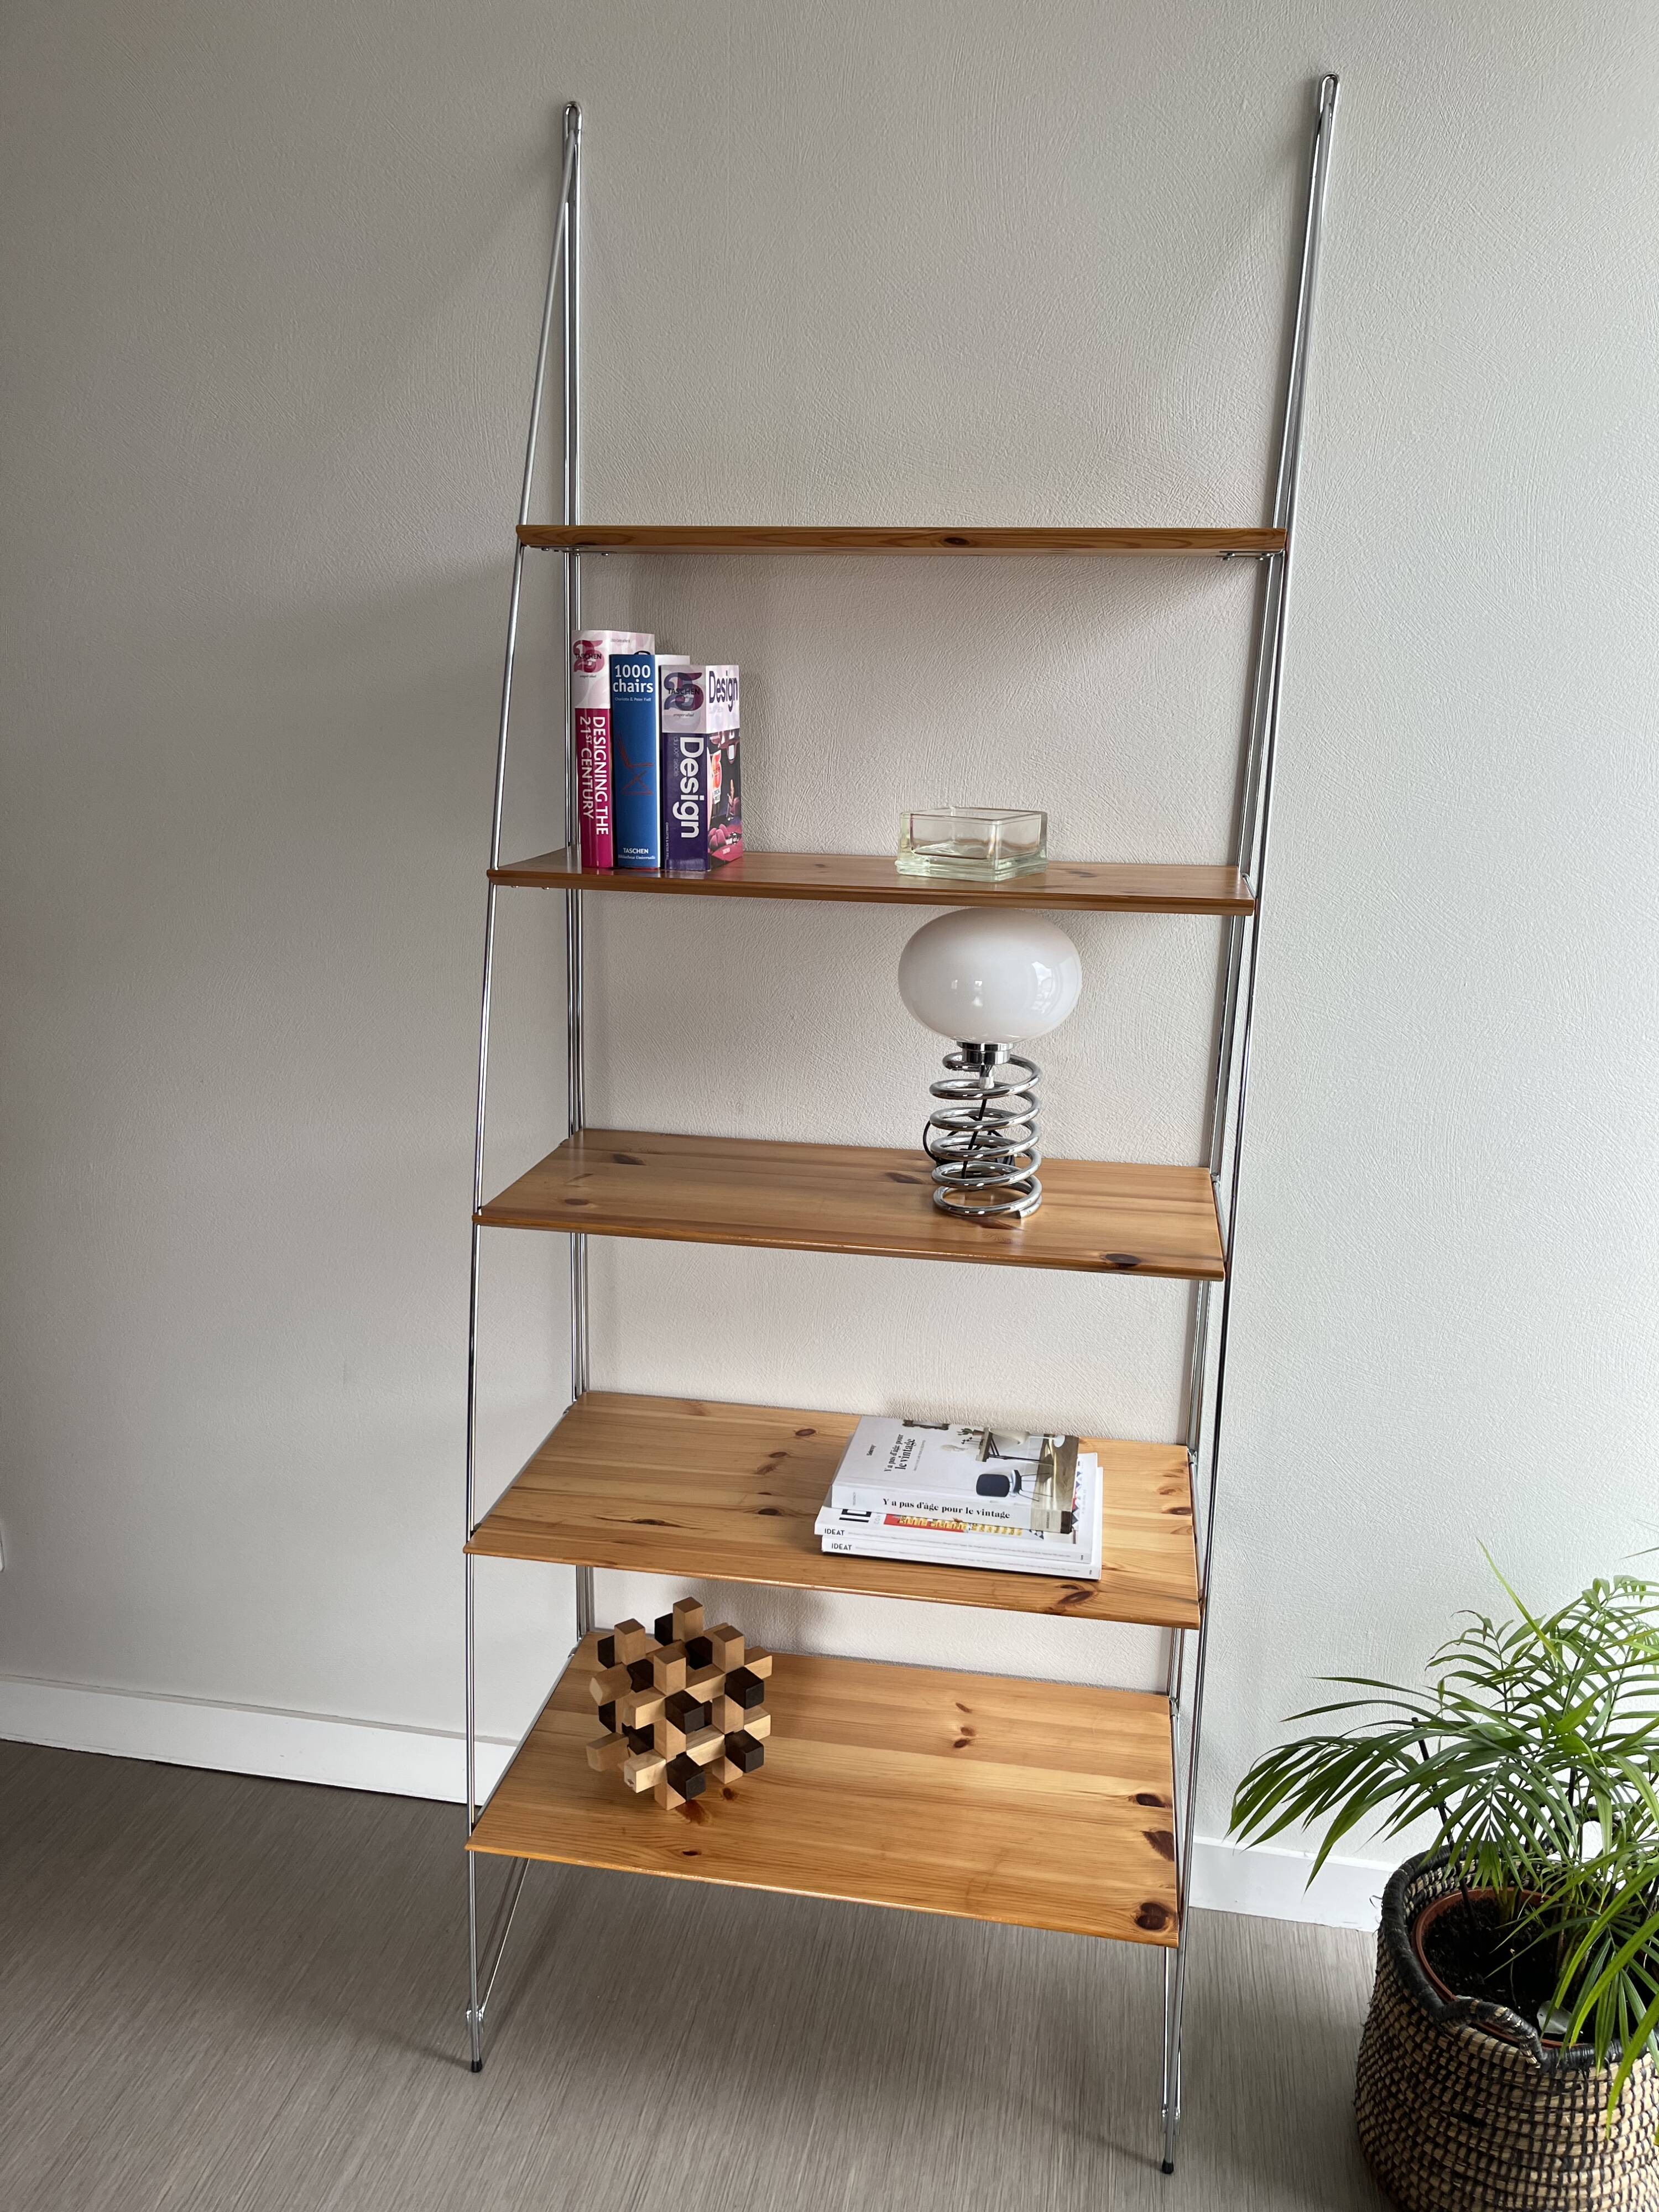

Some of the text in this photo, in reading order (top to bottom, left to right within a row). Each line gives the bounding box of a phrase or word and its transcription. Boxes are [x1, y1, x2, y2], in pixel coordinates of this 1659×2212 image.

[613, 679, 654, 693] chairs
[615, 665, 651, 679] 1000
[709, 670, 738, 712] Design
[581, 748, 594, 819] CENTURY
[593, 717, 608, 835] DESIGNING THE
[672, 737, 705, 838] Design
[898, 1438, 917, 1462] vintage
[976, 1509, 1010, 1519] vintage
